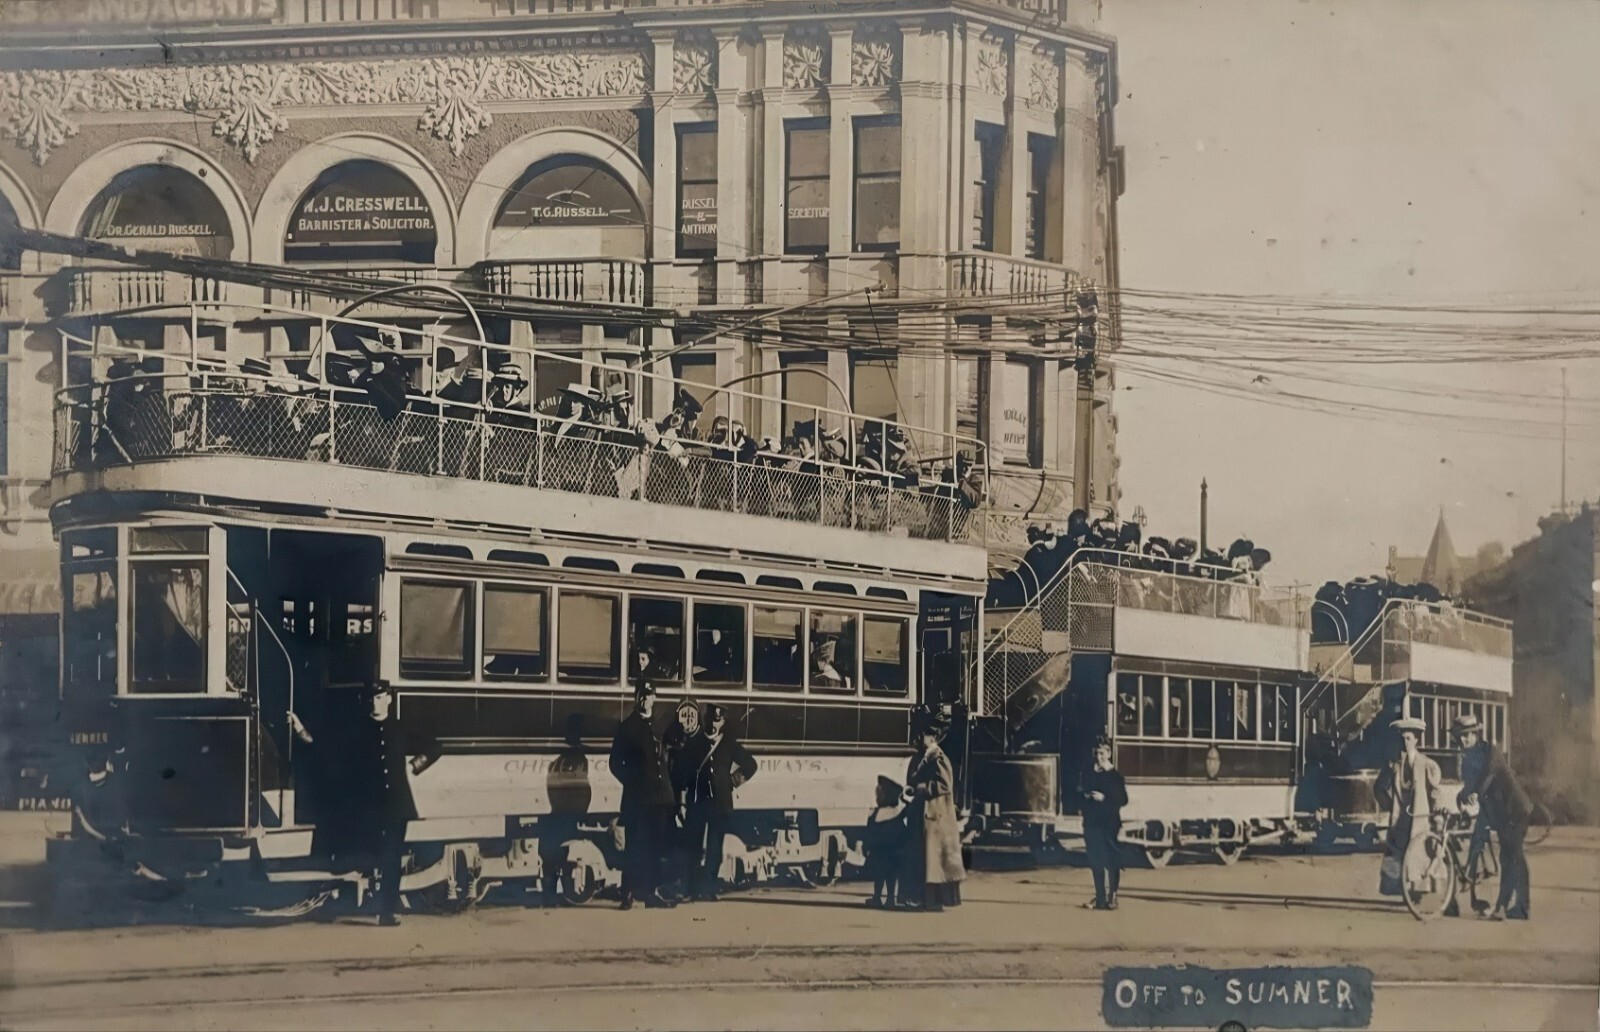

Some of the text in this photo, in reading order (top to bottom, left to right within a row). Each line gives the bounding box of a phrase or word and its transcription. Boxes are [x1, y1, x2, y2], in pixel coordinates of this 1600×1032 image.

[335, 196, 429, 213] CRESSWELL,
[125, 223, 166, 236] GERALD
[298, 218, 362, 231] BARRISTER
